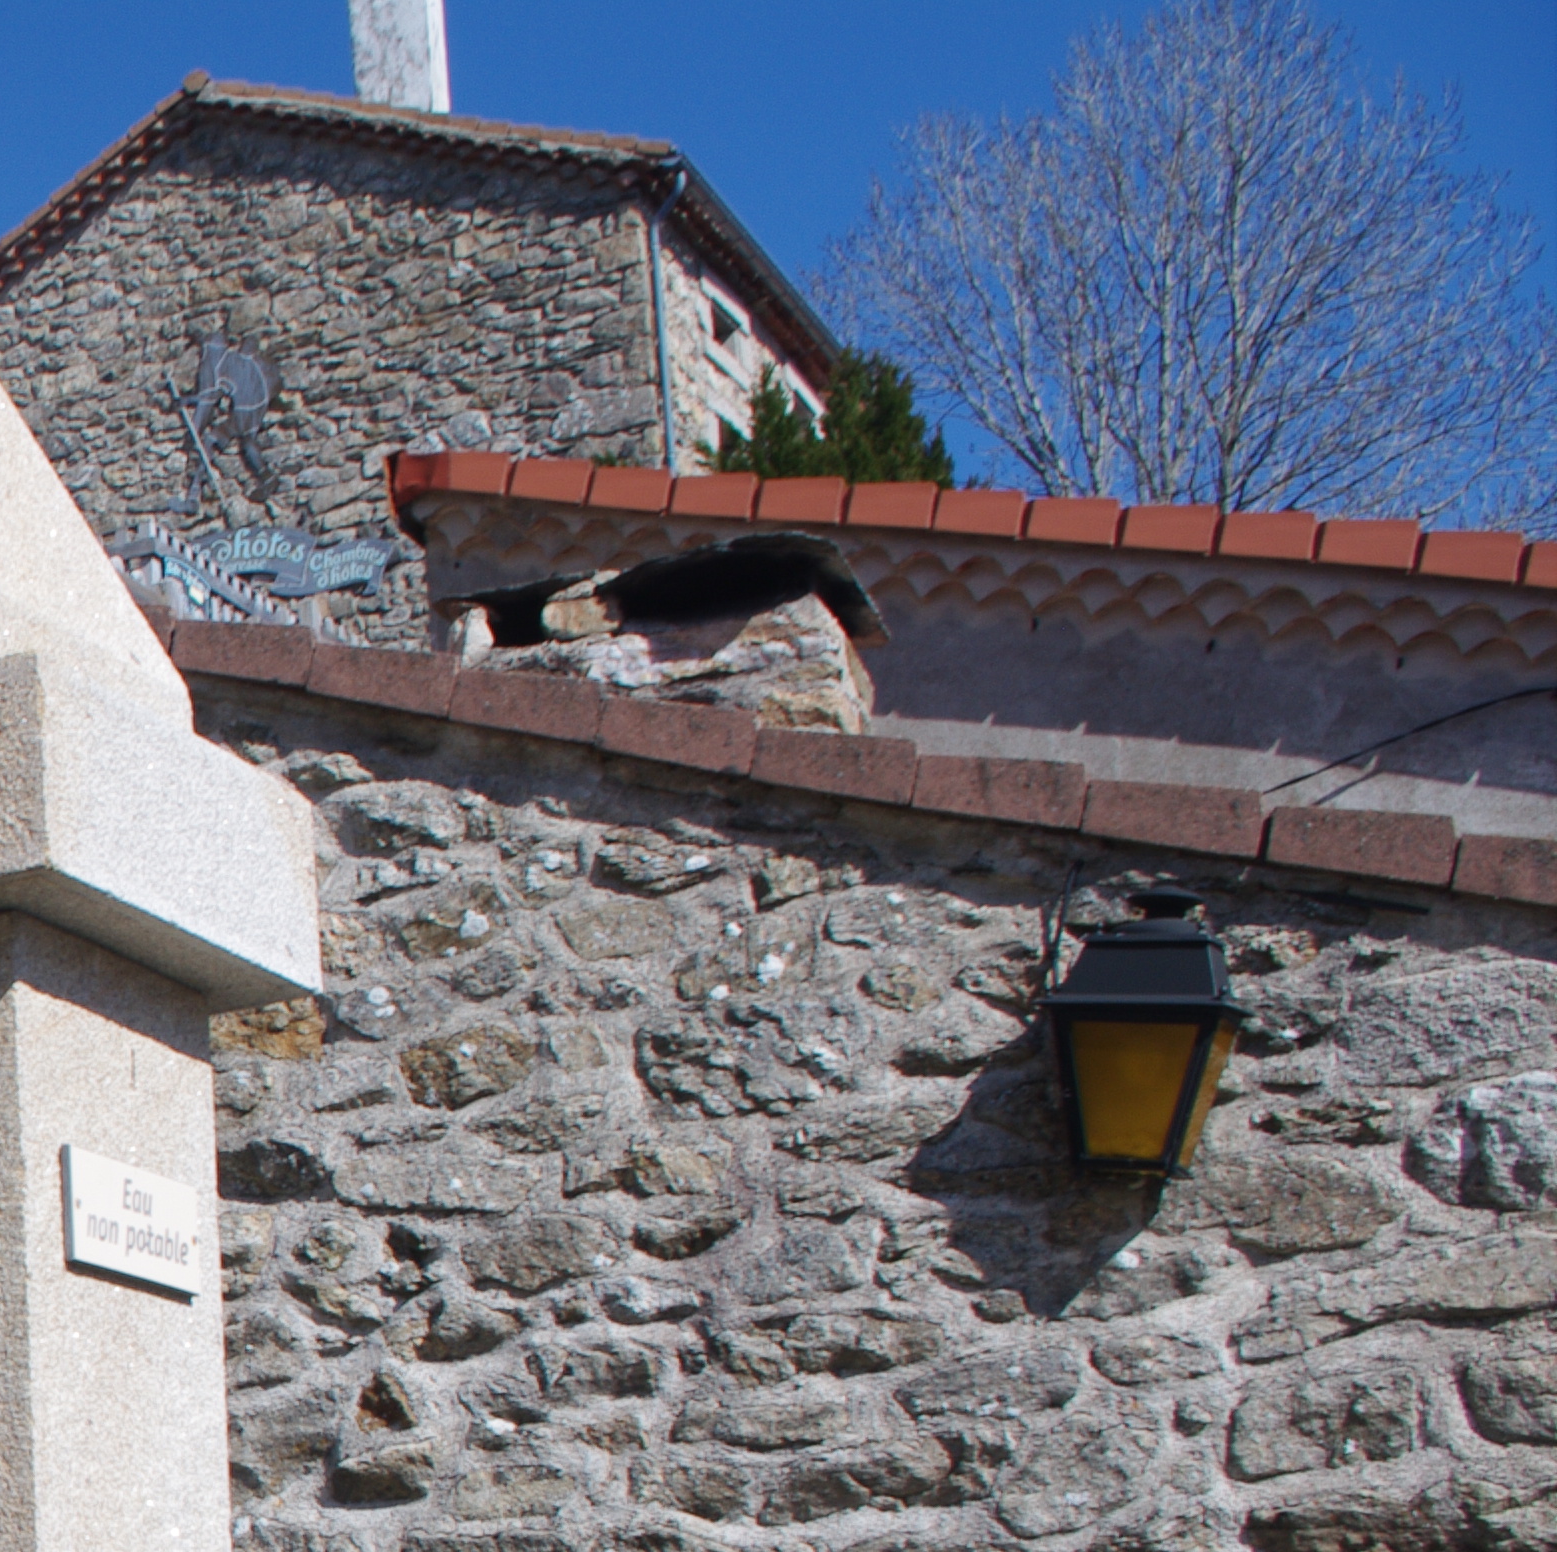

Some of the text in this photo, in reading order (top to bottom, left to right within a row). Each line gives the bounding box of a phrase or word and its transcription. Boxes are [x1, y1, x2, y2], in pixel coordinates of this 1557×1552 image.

[122, 1178, 153, 1217] Eau
[86, 1213, 189, 1266] non potable
